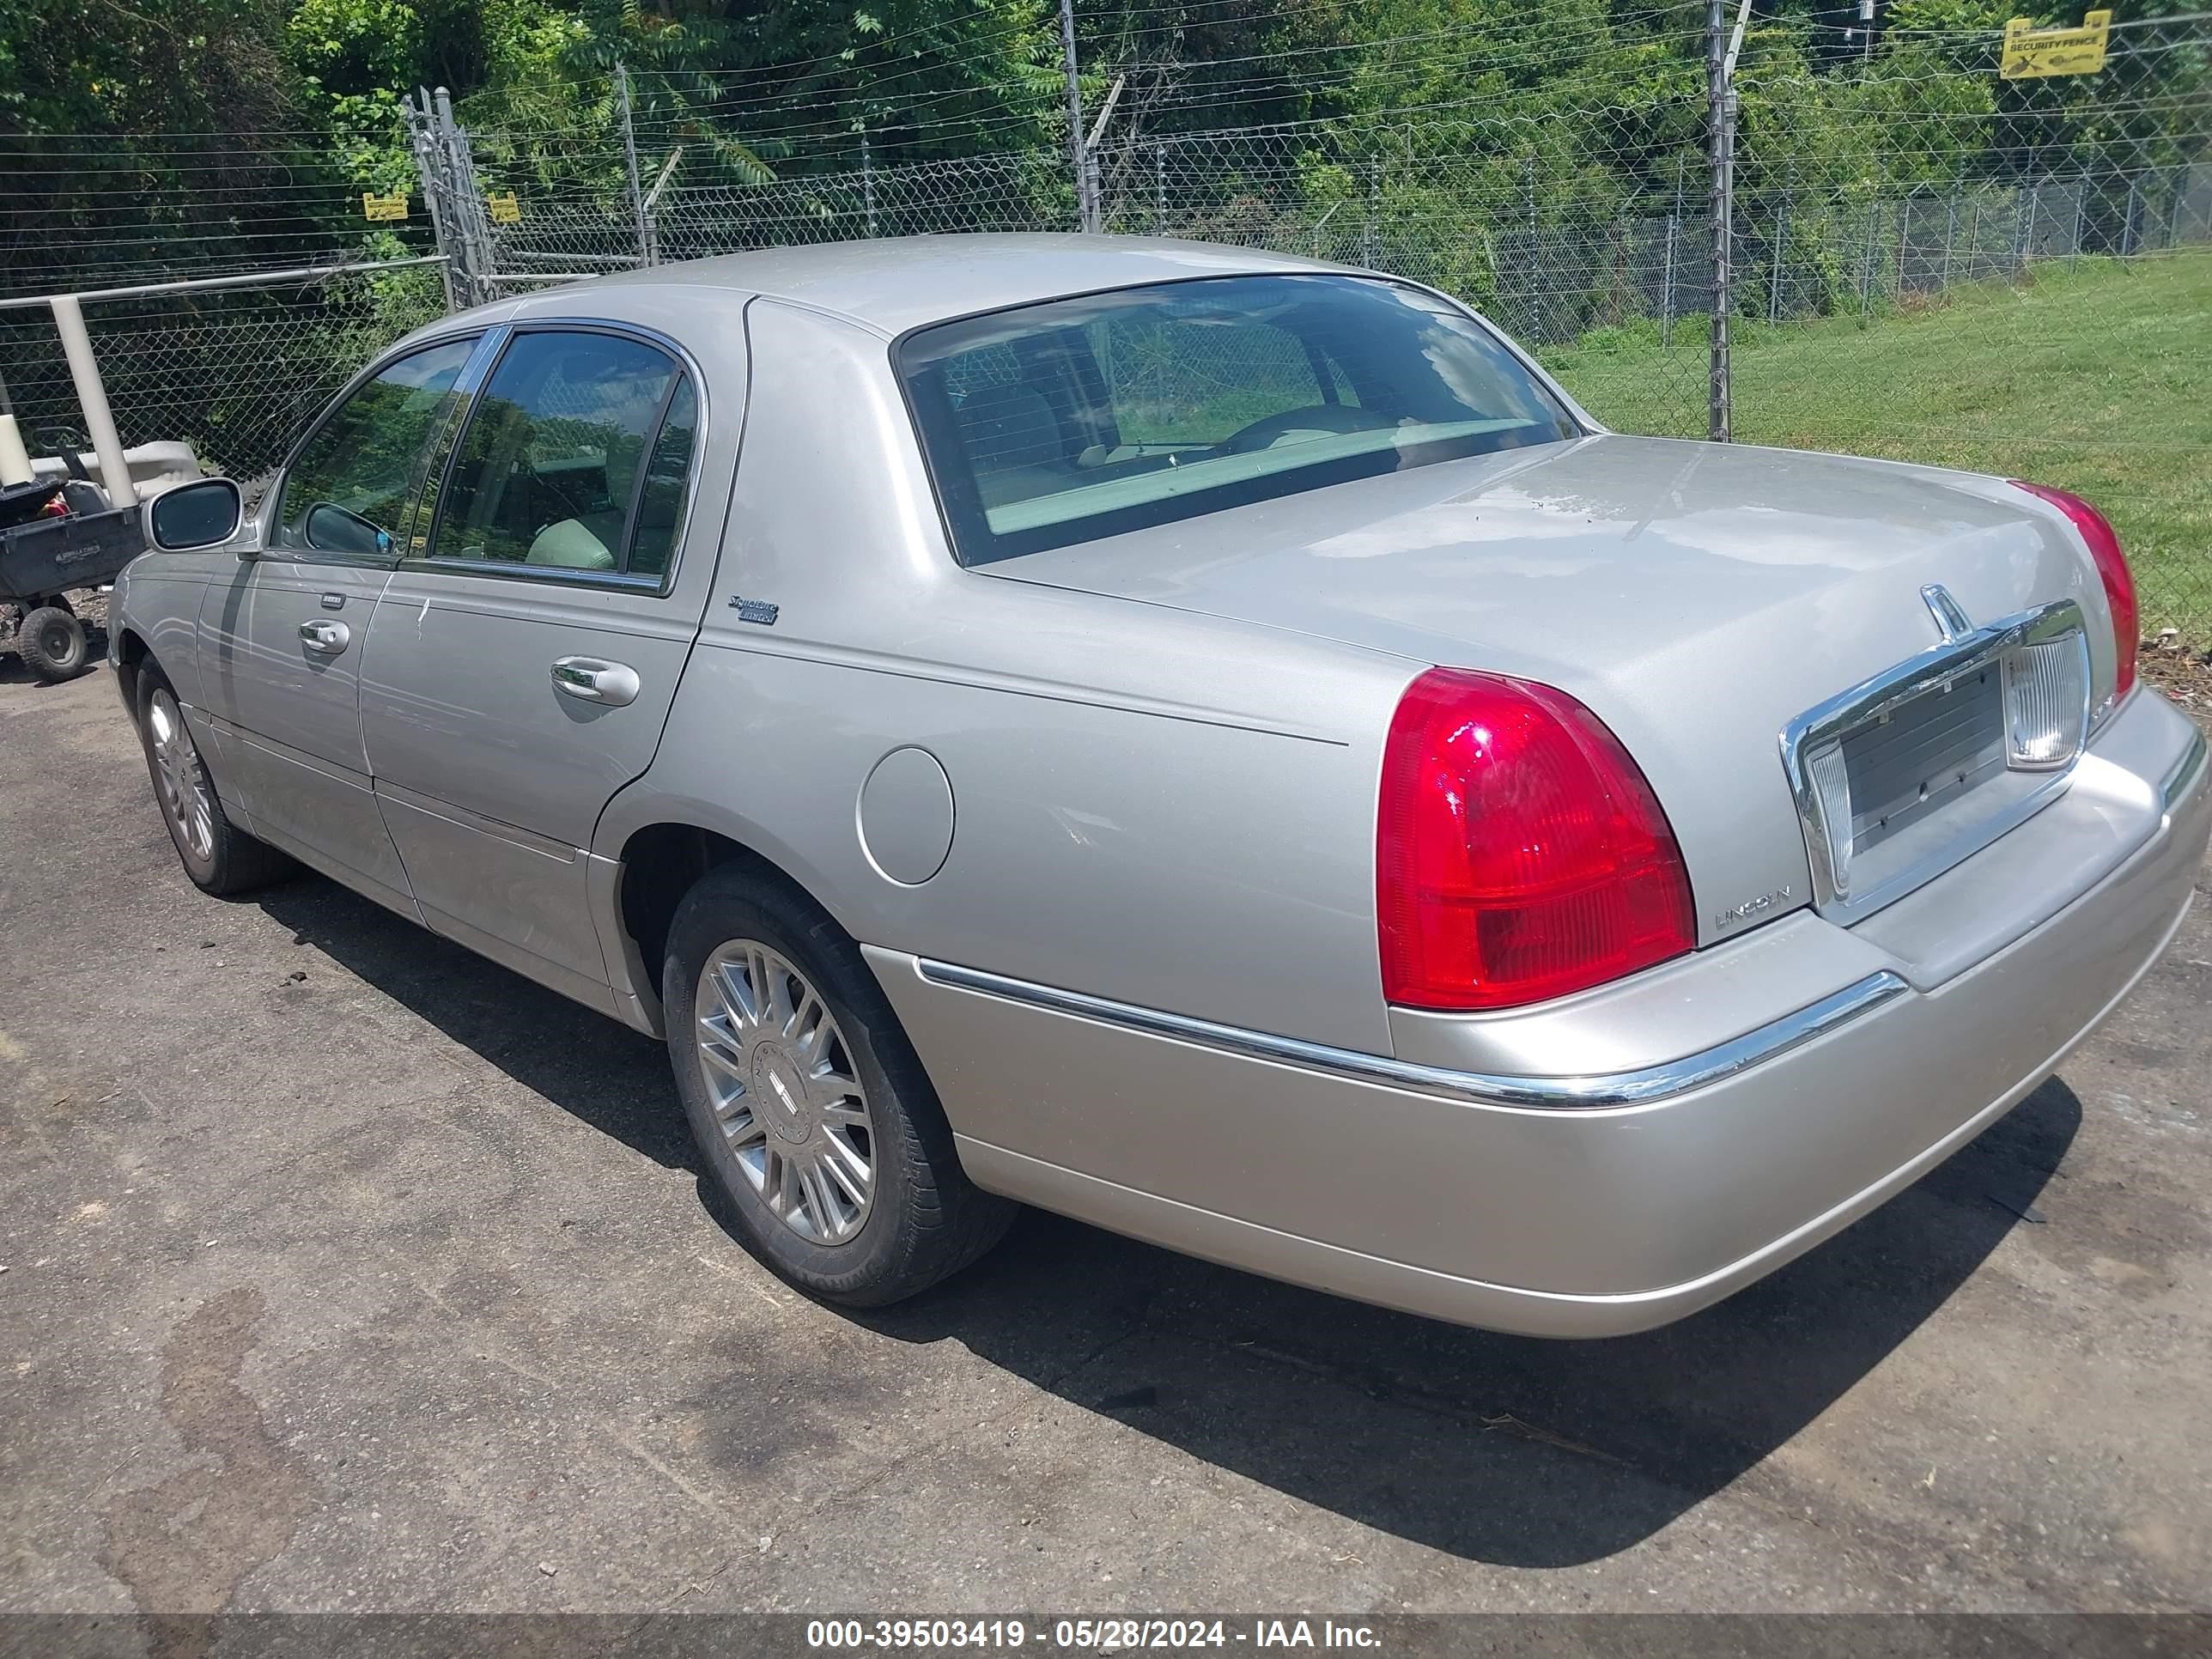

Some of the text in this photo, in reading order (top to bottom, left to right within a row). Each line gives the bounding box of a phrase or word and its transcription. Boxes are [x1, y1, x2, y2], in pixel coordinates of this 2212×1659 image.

[2010, 40, 2062, 52] SECURITY
[2063, 36, 2099, 48] FENCE
[1716, 885, 1790, 927] LINCOLN
